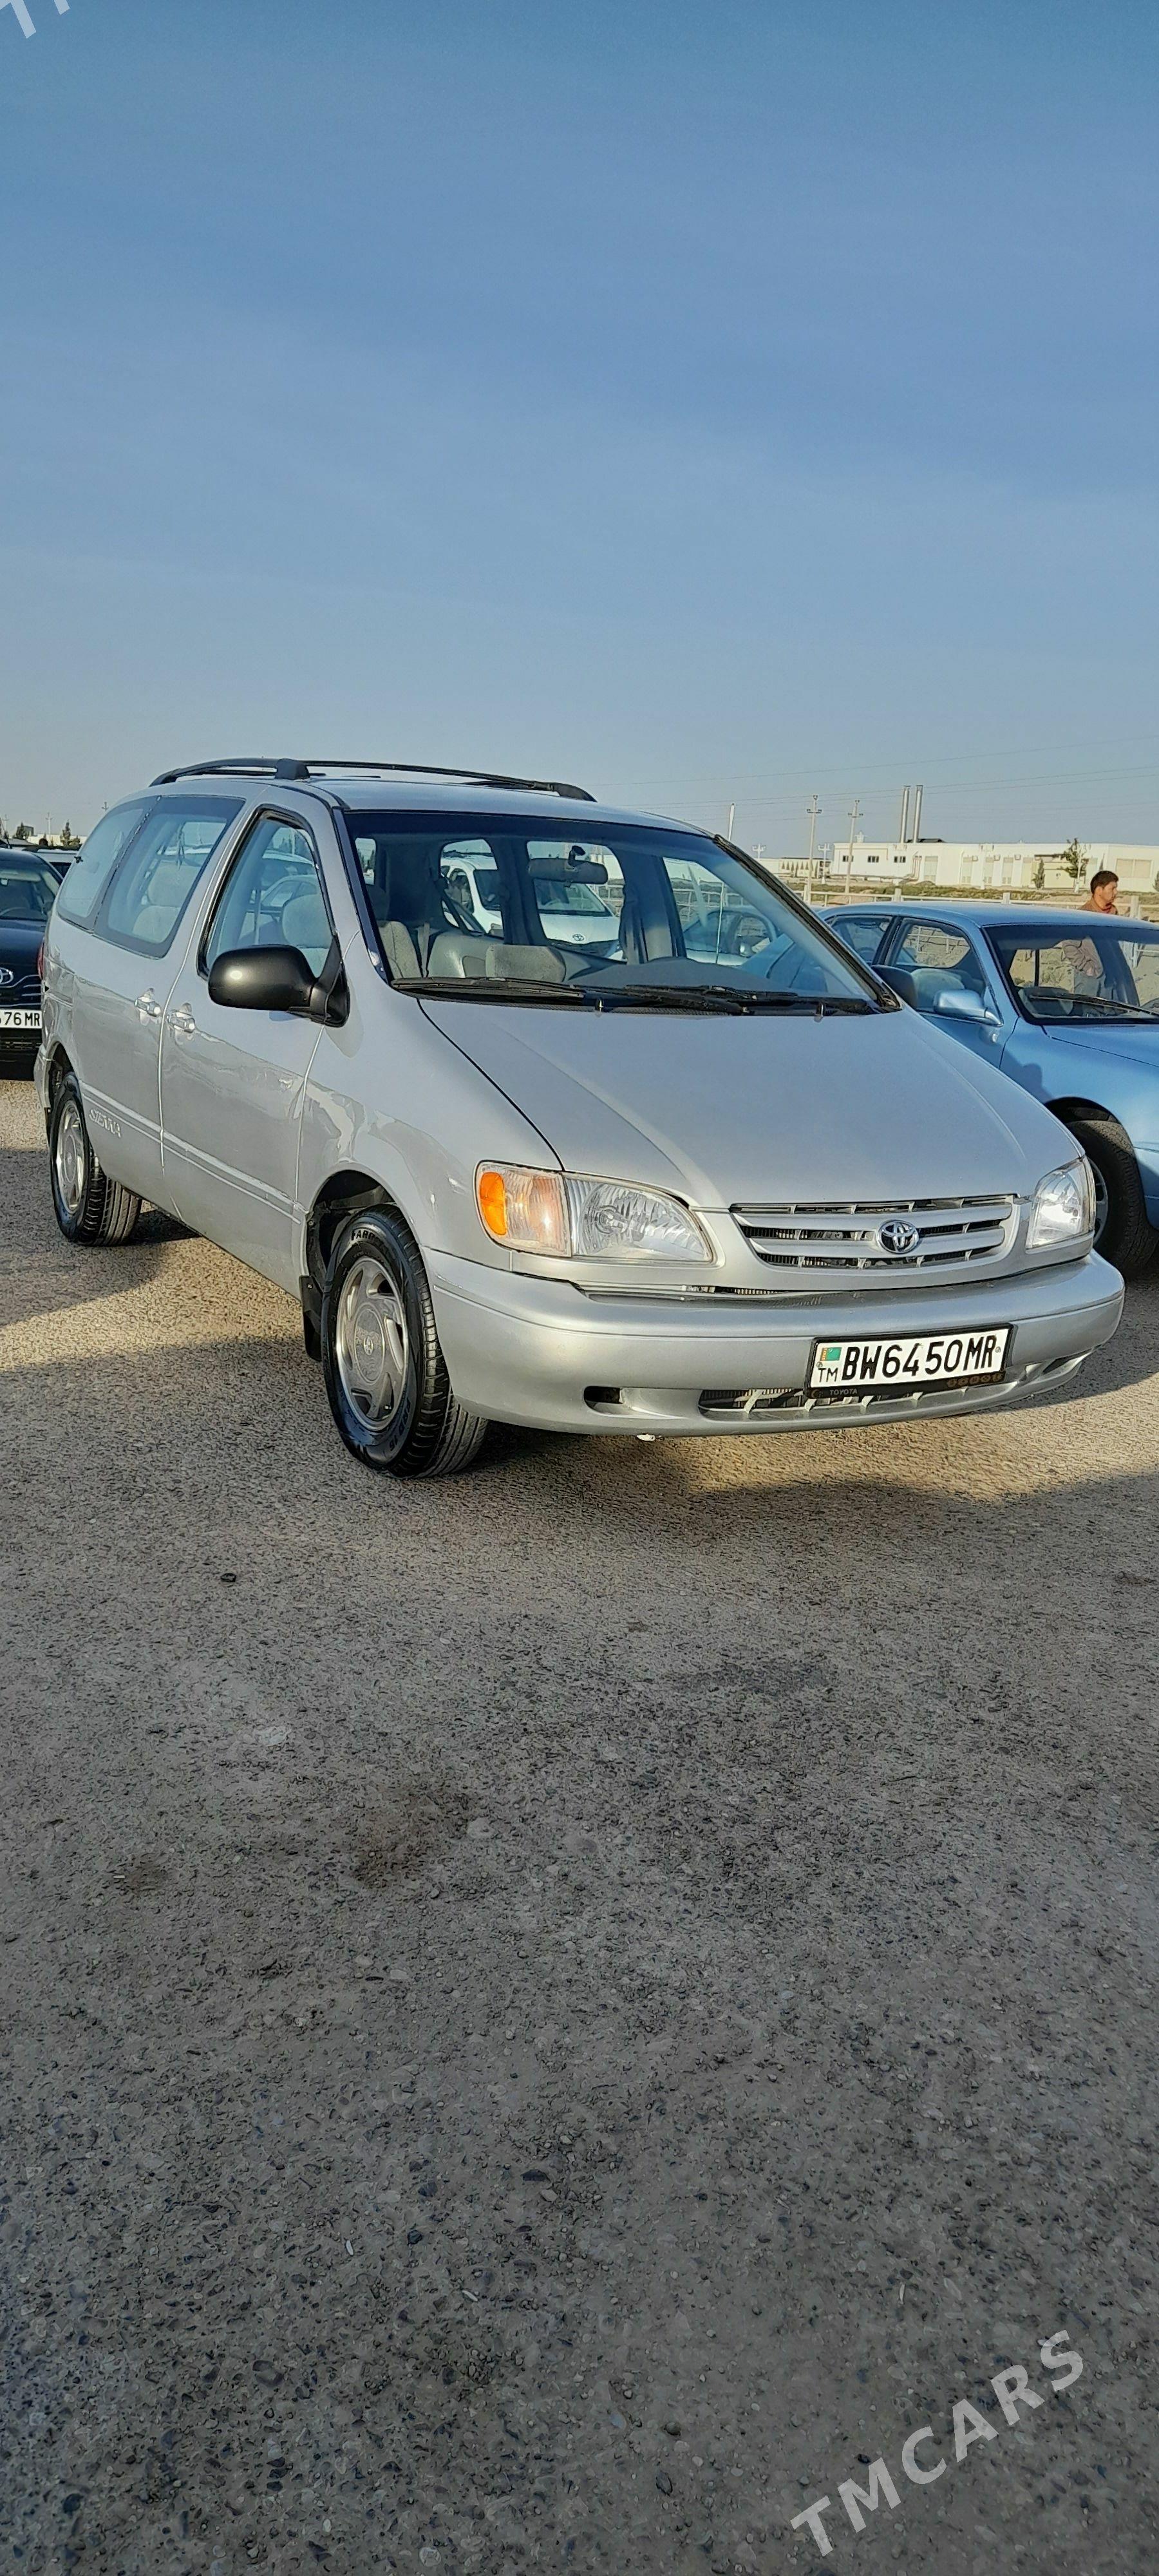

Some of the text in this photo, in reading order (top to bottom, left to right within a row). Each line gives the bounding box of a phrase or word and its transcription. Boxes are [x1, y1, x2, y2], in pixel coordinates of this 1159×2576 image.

[0, 1012, 40, 1026] 76MR
[817, 1336, 997, 1383] TM BW6450MR
